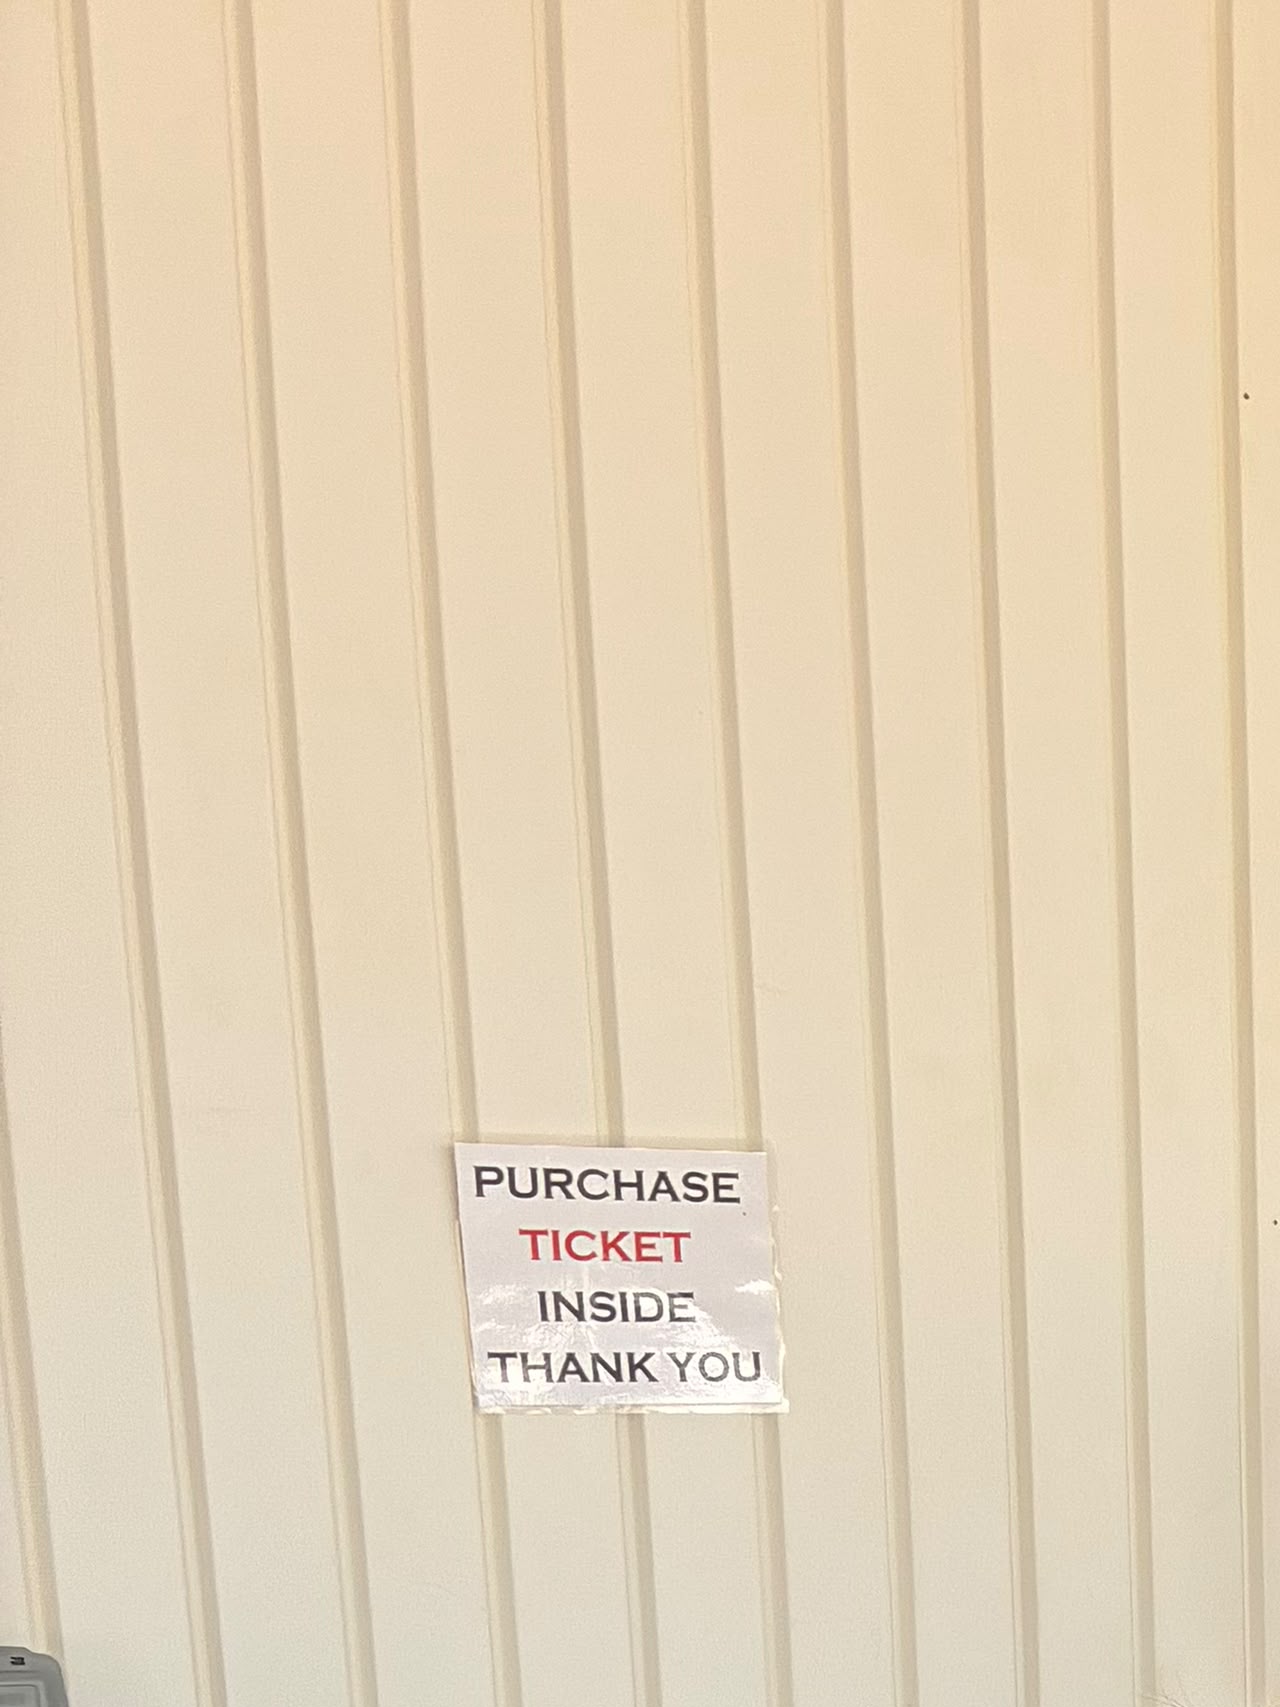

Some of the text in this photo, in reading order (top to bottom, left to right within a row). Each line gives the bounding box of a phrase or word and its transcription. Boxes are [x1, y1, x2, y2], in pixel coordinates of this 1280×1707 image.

[474, 1165, 741, 1204] PURCHASE
[518, 1228, 692, 1263] TICKET
[537, 1290, 696, 1323] INSIDE
[487, 1351, 761, 1383] THANK YOU
